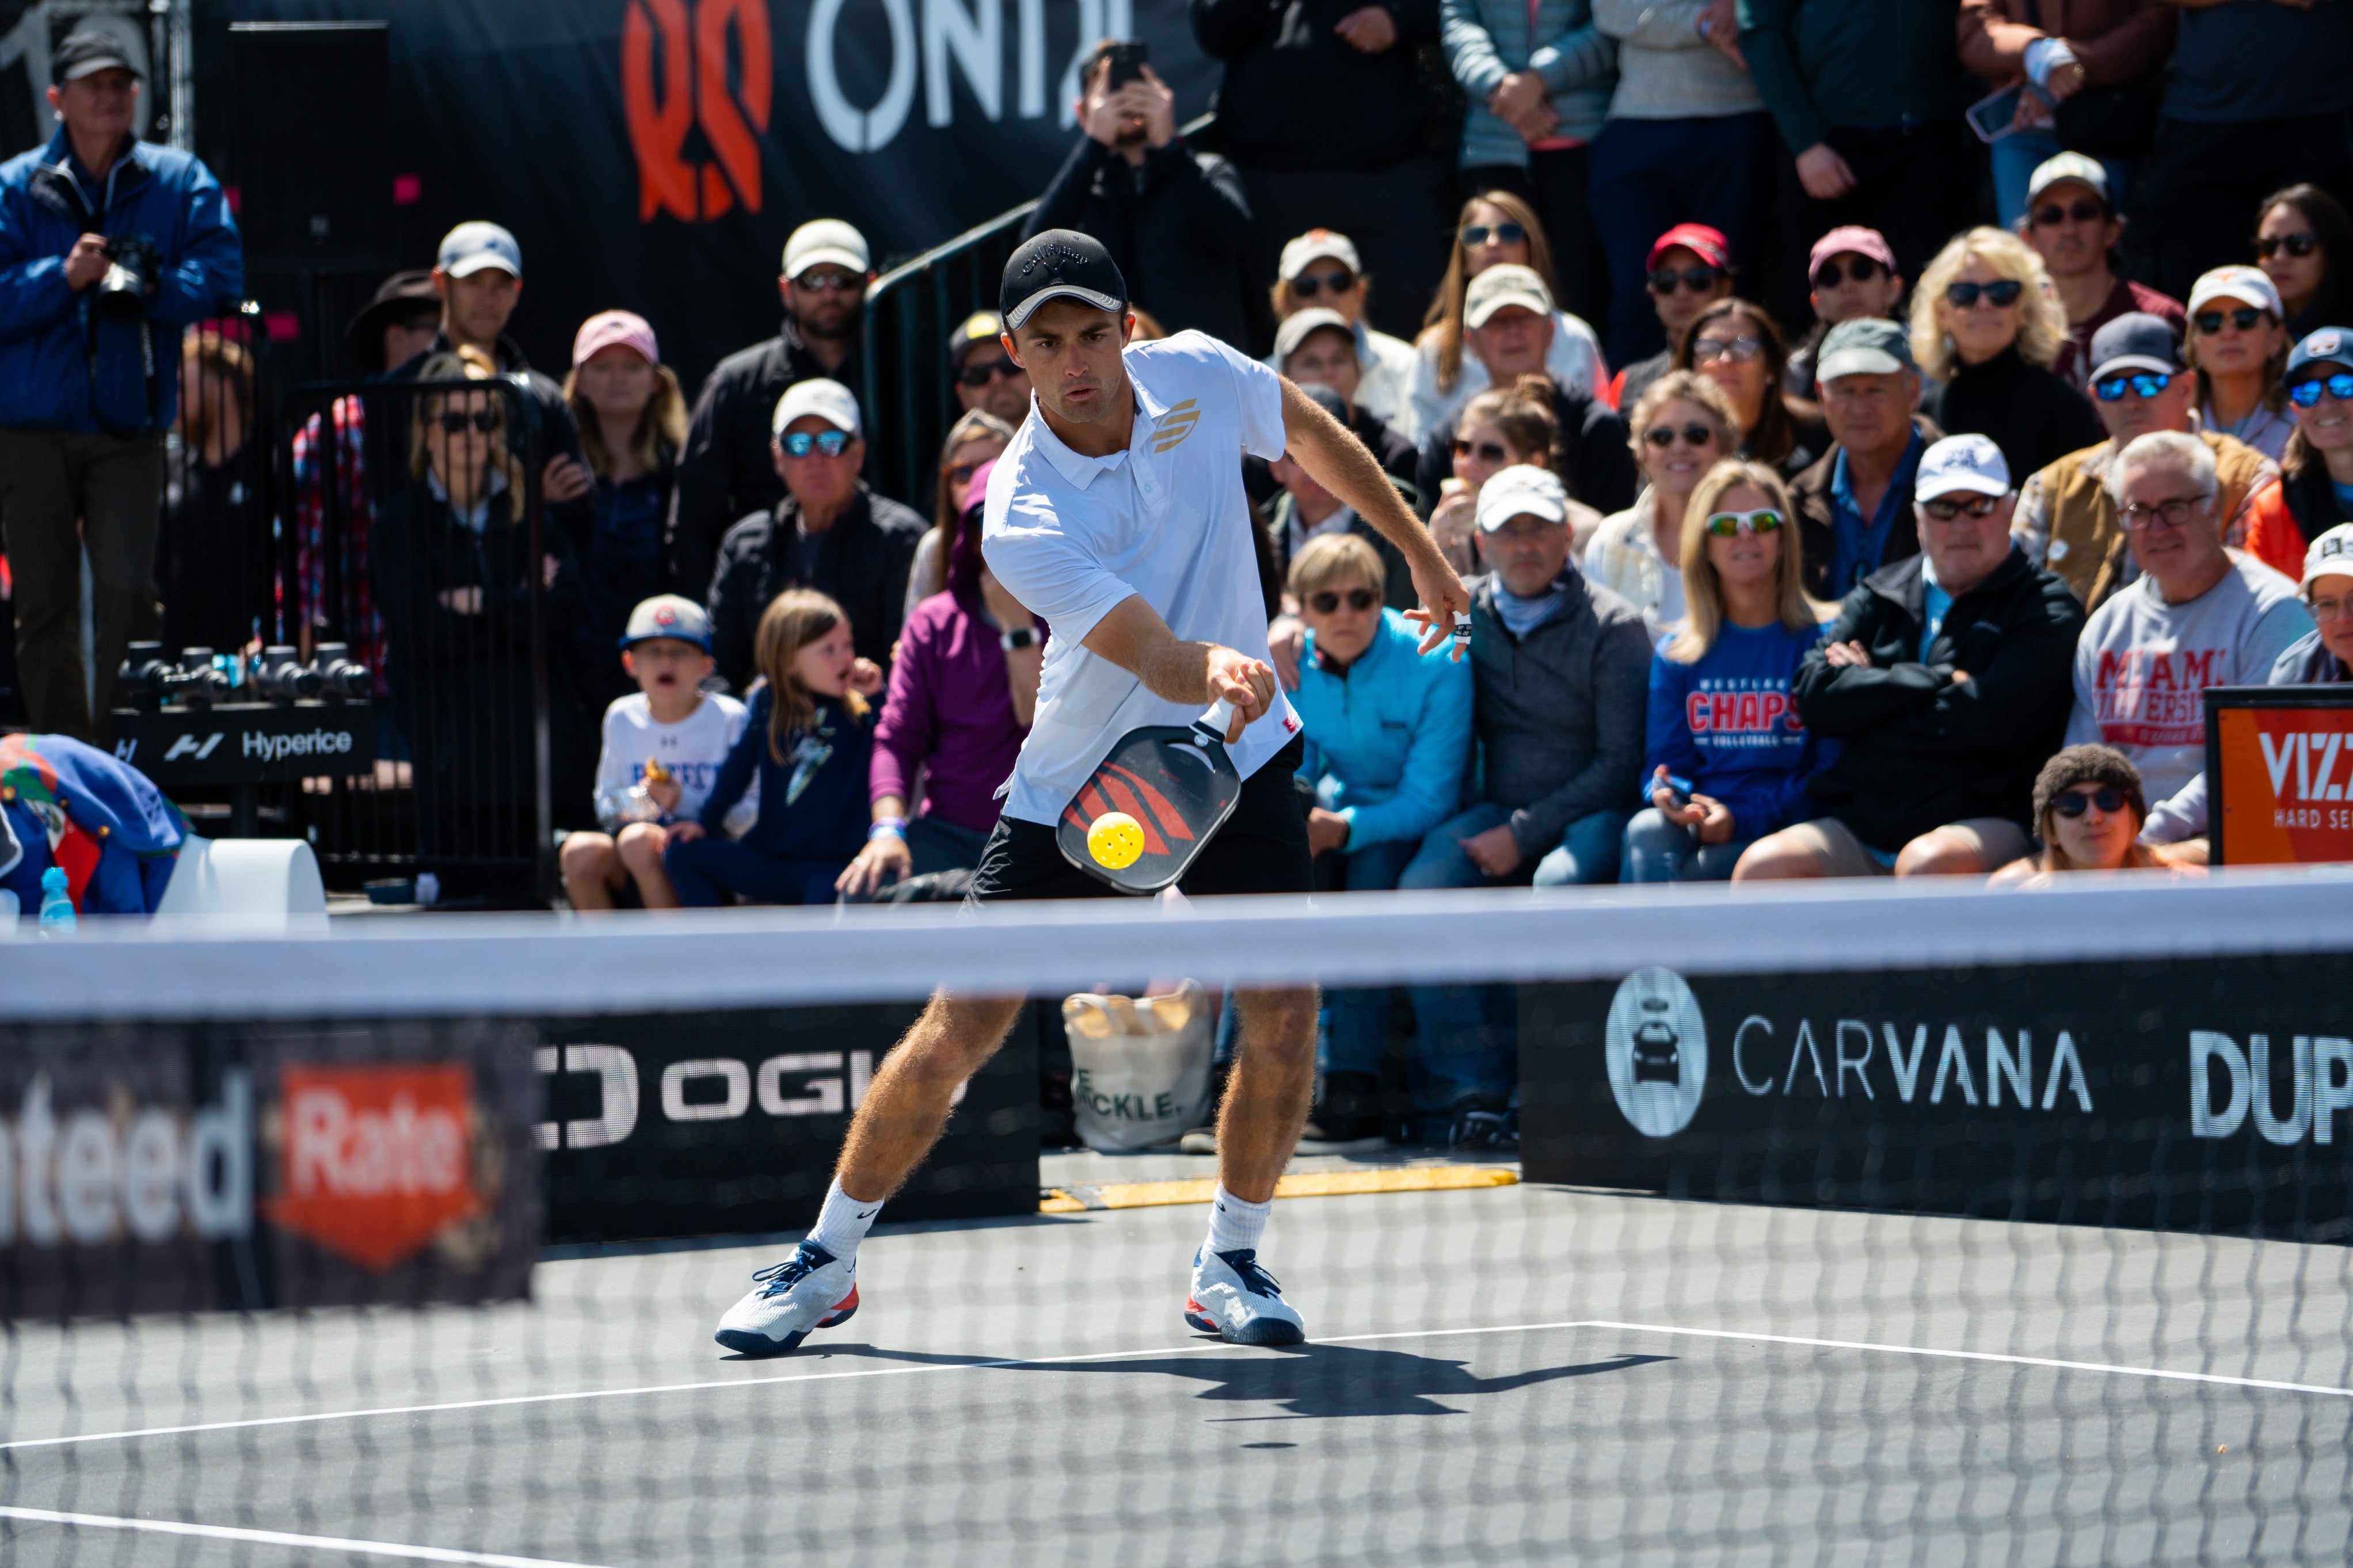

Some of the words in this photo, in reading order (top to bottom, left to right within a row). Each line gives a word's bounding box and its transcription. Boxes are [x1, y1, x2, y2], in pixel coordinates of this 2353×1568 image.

[1022, 243, 1088, 276] Callaway
[2095, 648, 2227, 690] MIAMI
[242, 727, 353, 762] Hyperice
[2258, 732, 2353, 801] VIZ
[2274, 808, 2321, 829] HARD
[1733, 1014, 2094, 1113] CARVANA
[290, 1084, 460, 1198] Rate
